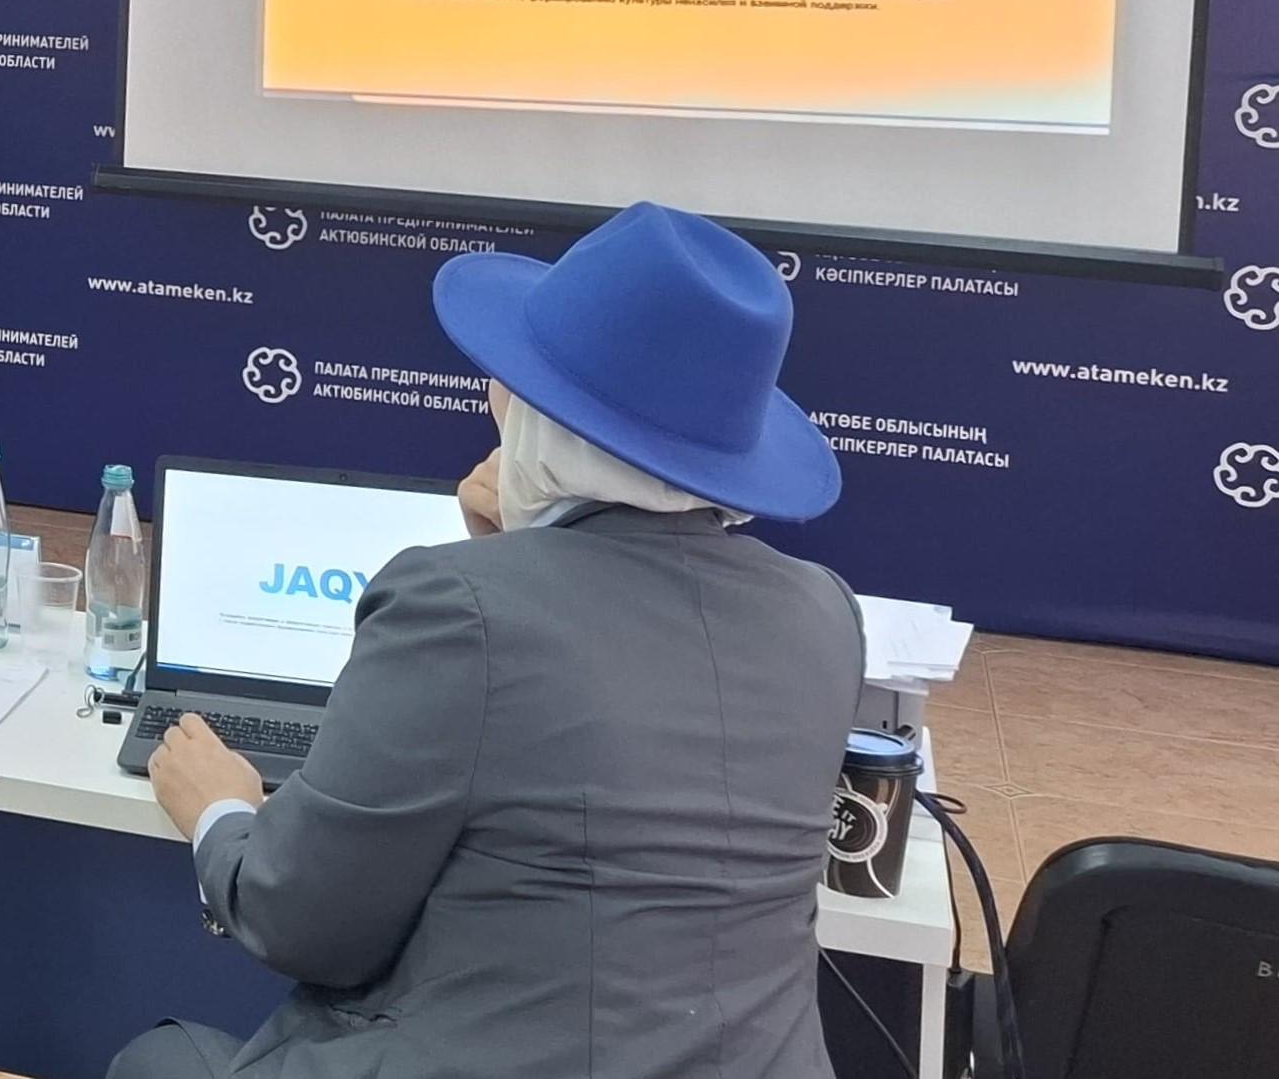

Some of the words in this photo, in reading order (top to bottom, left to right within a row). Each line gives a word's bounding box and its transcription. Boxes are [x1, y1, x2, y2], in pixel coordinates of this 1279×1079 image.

[319, 228, 427, 250] АКТЮБИНСКОЙ
[430, 237, 496, 253] ОБЛАСТИ
[87, 275, 254, 304] www.atameken.kz
[815, 267, 927, 290] КӘСІПКЕРЛЕР
[931, 276, 1019, 297] ПАЛАТАСЫ
[314, 361, 368, 380] ПАЛАТА
[371, 367, 490, 392] ПРЕДПРИНИМАТ
[1011, 358, 1229, 393] www.atameken.kz
[313, 383, 420, 408] АКТЮБИНСКОЙ
[423, 396, 490, 415] ОБЛАСТИ
[876, 418, 987, 444] ОБЛЫСЫНЫҢ
[825, 435, 918, 458] СІПКЕРЛЕР
[922, 446, 1010, 468] ПАЛАТАСЫ
